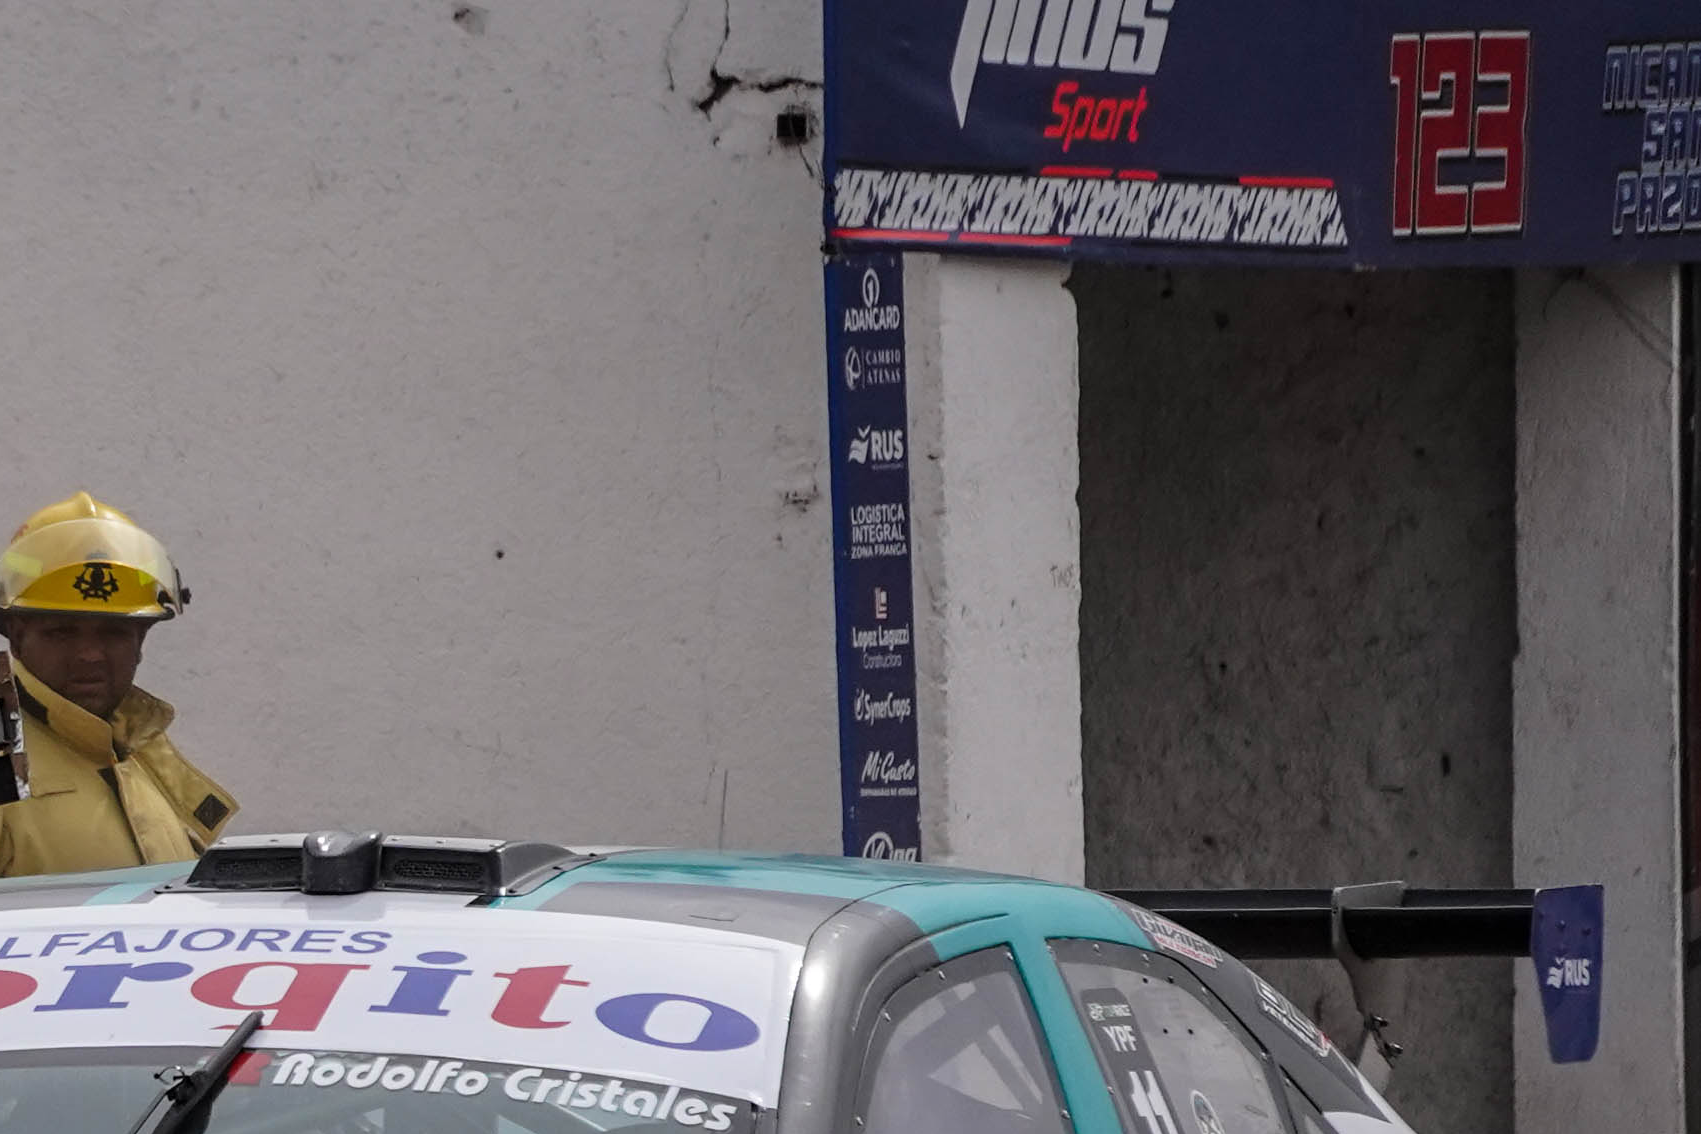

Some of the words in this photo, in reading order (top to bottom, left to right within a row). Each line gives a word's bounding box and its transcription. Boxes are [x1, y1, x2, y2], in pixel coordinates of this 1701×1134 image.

[1042, 80, 1148, 152] Sport
[1388, 29, 1531, 237] 123
[844, 304, 900, 332] ADANCARD
[870, 429, 904, 462] RUS
[850, 503, 905, 526] LOGISTICA
[852, 524, 906, 543] INTEGRAL
[850, 545, 874, 560] ZONA
[874, 542, 908, 557] FRANCA
[1564, 957, 1591, 987] RUS
[1101, 1024, 1138, 1052] YPF
[272, 1052, 489, 1097] Rodolfo
[504, 1067, 737, 1132] Cristales
